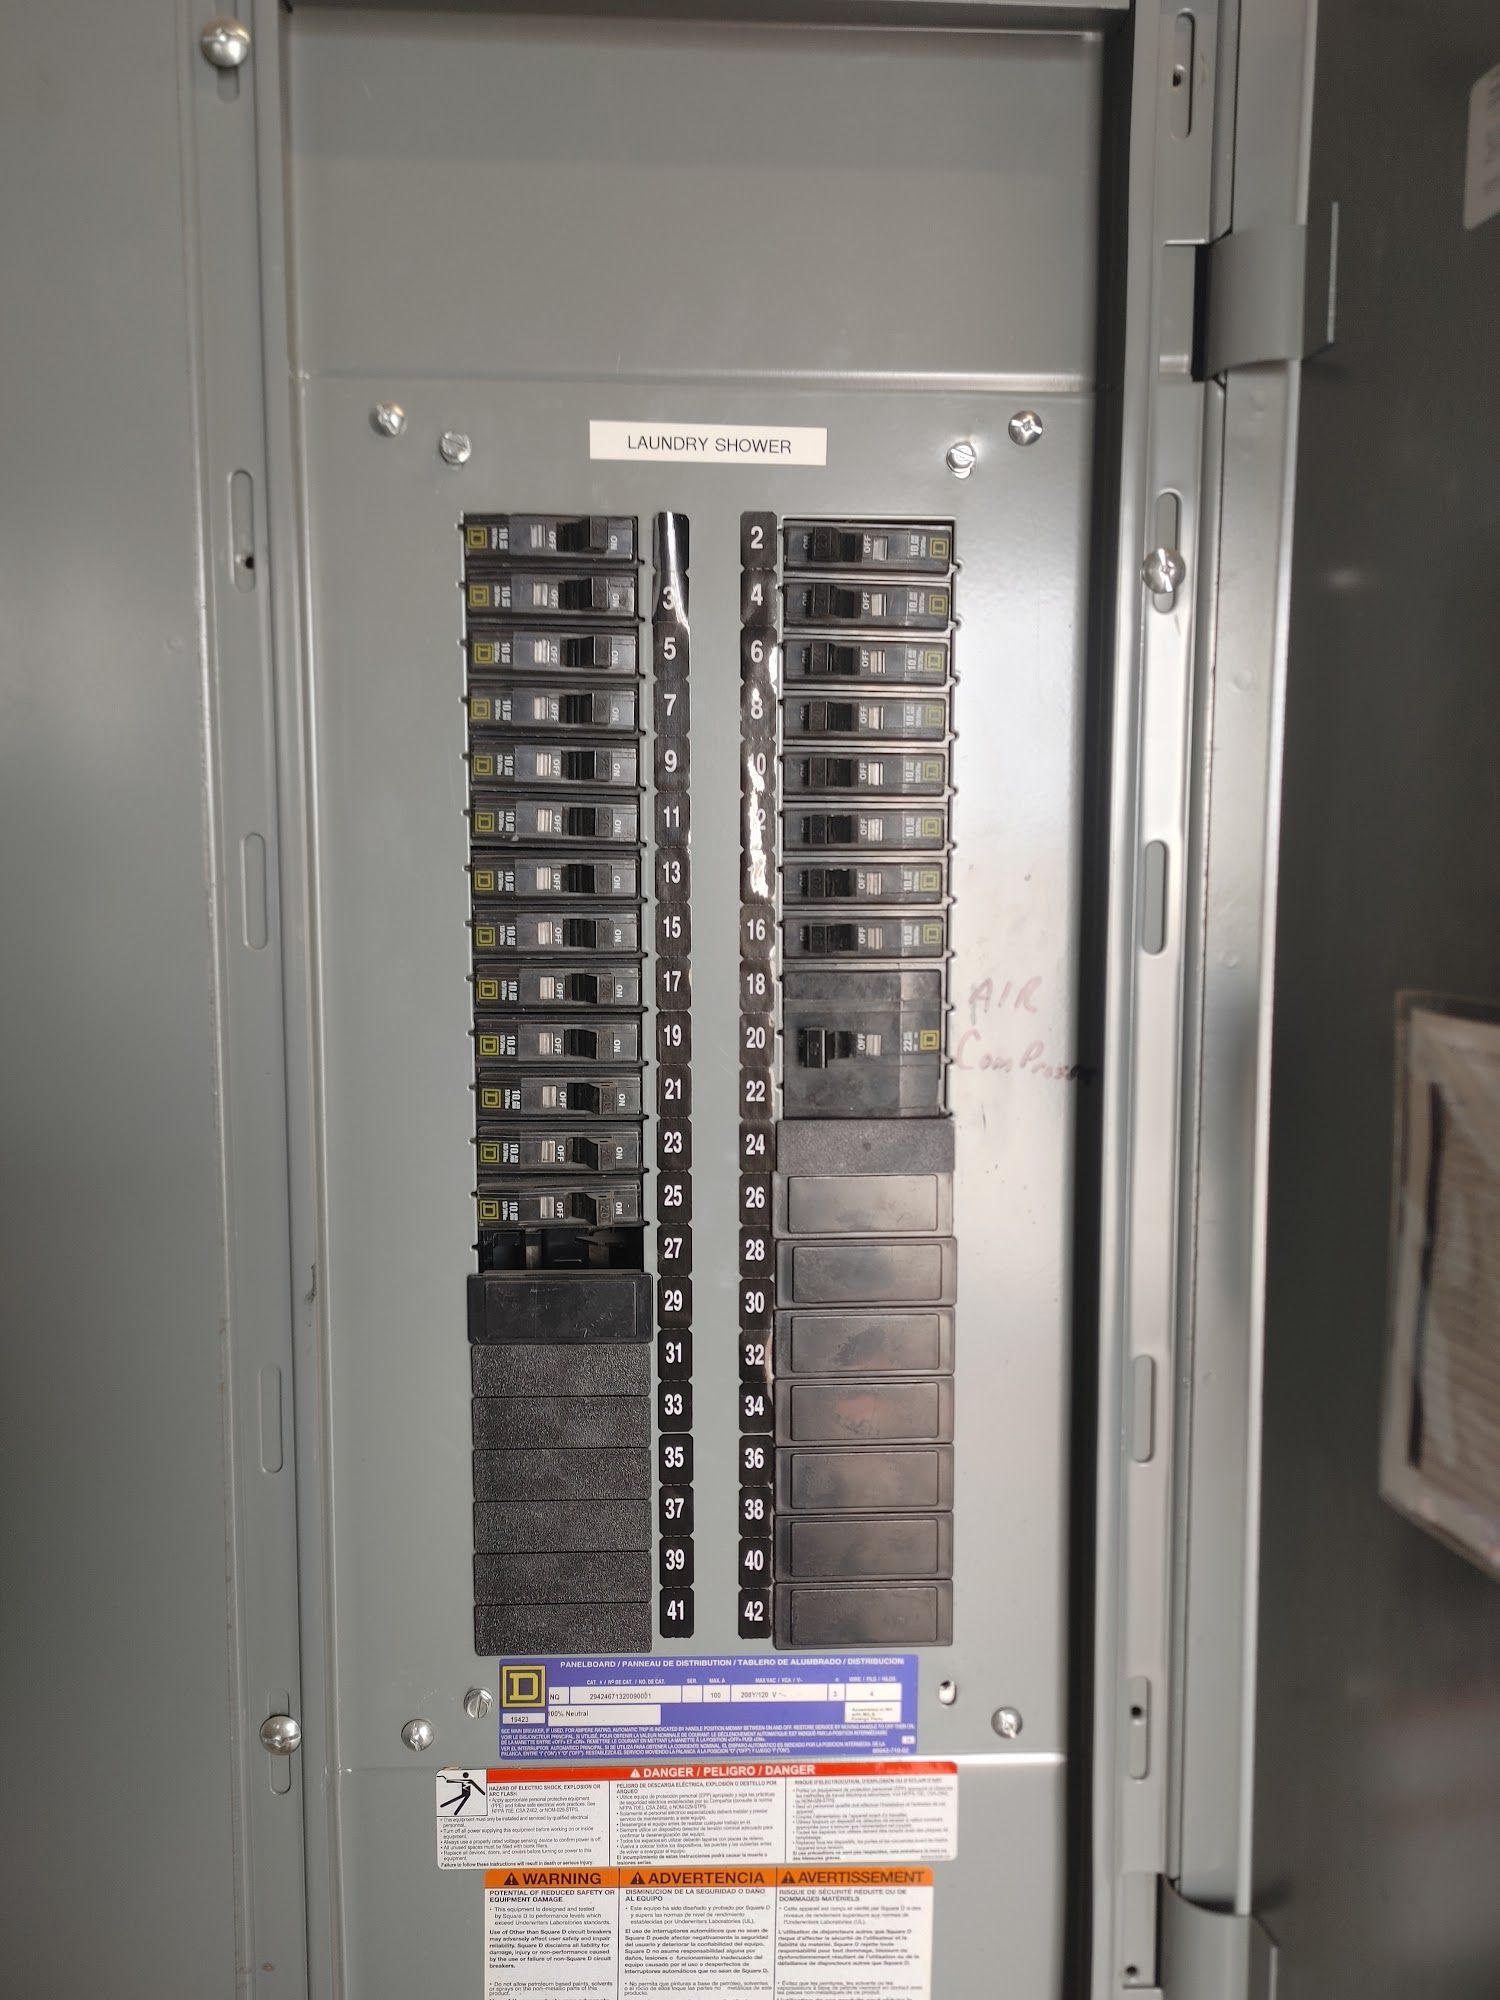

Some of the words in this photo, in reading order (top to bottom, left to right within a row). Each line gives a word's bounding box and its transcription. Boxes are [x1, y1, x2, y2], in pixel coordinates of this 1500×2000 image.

[627, 435, 708, 453] LAUNDRY
[714, 437, 792, 455] SHOWER
[610, 535, 618, 550] ON
[750, 526, 763, 549] 2
[864, 535, 872, 553] OFF
[612, 593, 620, 607] ON
[663, 586, 677, 610] 3
[750, 584, 763, 606] 4
[862, 592, 870, 610] OFF
[550, 646, 558, 664] OFF
[612, 650, 618, 664] ON
[663, 637, 677, 660] 5
[750, 640, 764, 663] 6
[663, 694, 677, 716] 7
[751, 687, 764, 719] 8
[612, 707, 620, 722] ON
[552, 758, 560, 776] OFF
[613, 763, 620, 777] ON
[664, 750, 678, 772] 9
[859, 762, 867, 780] OFF
[614, 820, 622, 833] ON
[663, 806, 680, 827] 11
[614, 876, 620, 889] ON
[663, 861, 681, 883] 13
[858, 872, 866, 890] OFF
[554, 927, 562, 944] OFF
[614, 929, 622, 943] ON
[663, 916, 682, 938] 15
[746, 919, 766, 940] 16
[858, 927, 866, 944] OFF
[556, 982, 564, 1000] OFF
[616, 984, 623, 998] ON
[663, 971, 682, 992] 17
[746, 973, 766, 995] 18
[968, 976, 1042, 1014] AIR
[614, 1039, 621, 1052] ON
[663, 1025, 682, 1046] 19
[746, 1027, 766, 1049] 20
[858, 1034, 866, 1050] OFF
[664, 1079, 682, 1099] 21
[746, 1080, 766, 1102] 22
[618, 1094, 625, 1107] ON
[616, 1146, 622, 1160] ON
[664, 1132, 683, 1153] 23
[745, 1134, 765, 1155] 24
[664, 1185, 683, 1206] 25
[745, 1187, 765, 1208] 26
[556, 1202, 564, 1218] OFF
[615, 1202, 622, 1214] ON
[664, 1238, 683, 1258] 27
[745, 1239, 765, 1261] 28
[664, 1290, 683, 1311] 29
[745, 1292, 765, 1313] 30
[665, 1342, 682, 1363] 31
[745, 1344, 765, 1365] 32
[664, 1394, 683, 1415] 33
[744, 1396, 764, 1417] 34
[665, 1447, 684, 1467] 35
[744, 1448, 764, 1469] 36
[665, 1498, 684, 1519] 37
[744, 1499, 764, 1520] 38
[665, 1549, 685, 1570] 39
[744, 1550, 764, 1571] 40
[666, 1600, 684, 1621] 41
[744, 1601, 764, 1622] 42
[509, 1672, 538, 1700] D
[644, 1768, 694, 1777] DANGER
[704, 1766, 755, 1776] PELIGRO
[765, 1765, 816, 1775] DANGER
[523, 1873, 602, 1884] WARNING
[648, 1872, 764, 1884] ADVERTENCIA
[798, 1871, 924, 1883] AVERTISSEMENT
